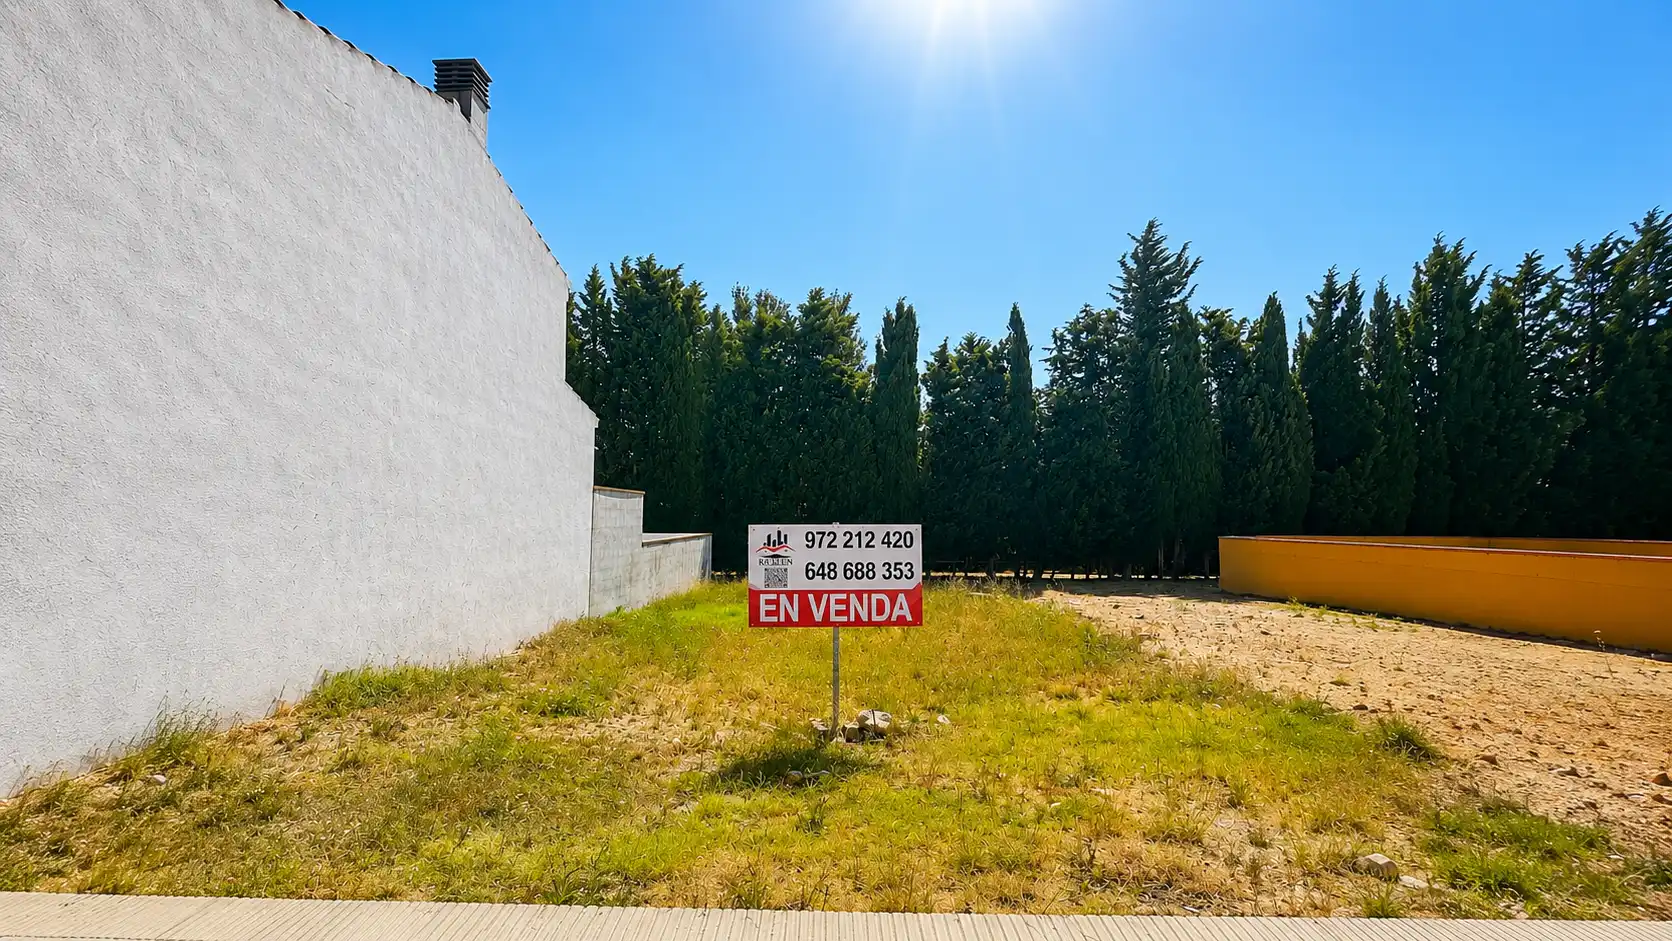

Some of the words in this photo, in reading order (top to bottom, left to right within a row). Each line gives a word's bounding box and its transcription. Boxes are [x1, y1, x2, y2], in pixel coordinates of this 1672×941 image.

[805, 531, 838, 549] 972
[842, 531, 876, 549] 212
[881, 531, 914, 549] 420
[805, 562, 838, 580] 648
[843, 562, 876, 580] 688
[881, 562, 915, 580] 353
[759, 593, 799, 622] EN
[808, 593, 913, 622] VENDA
